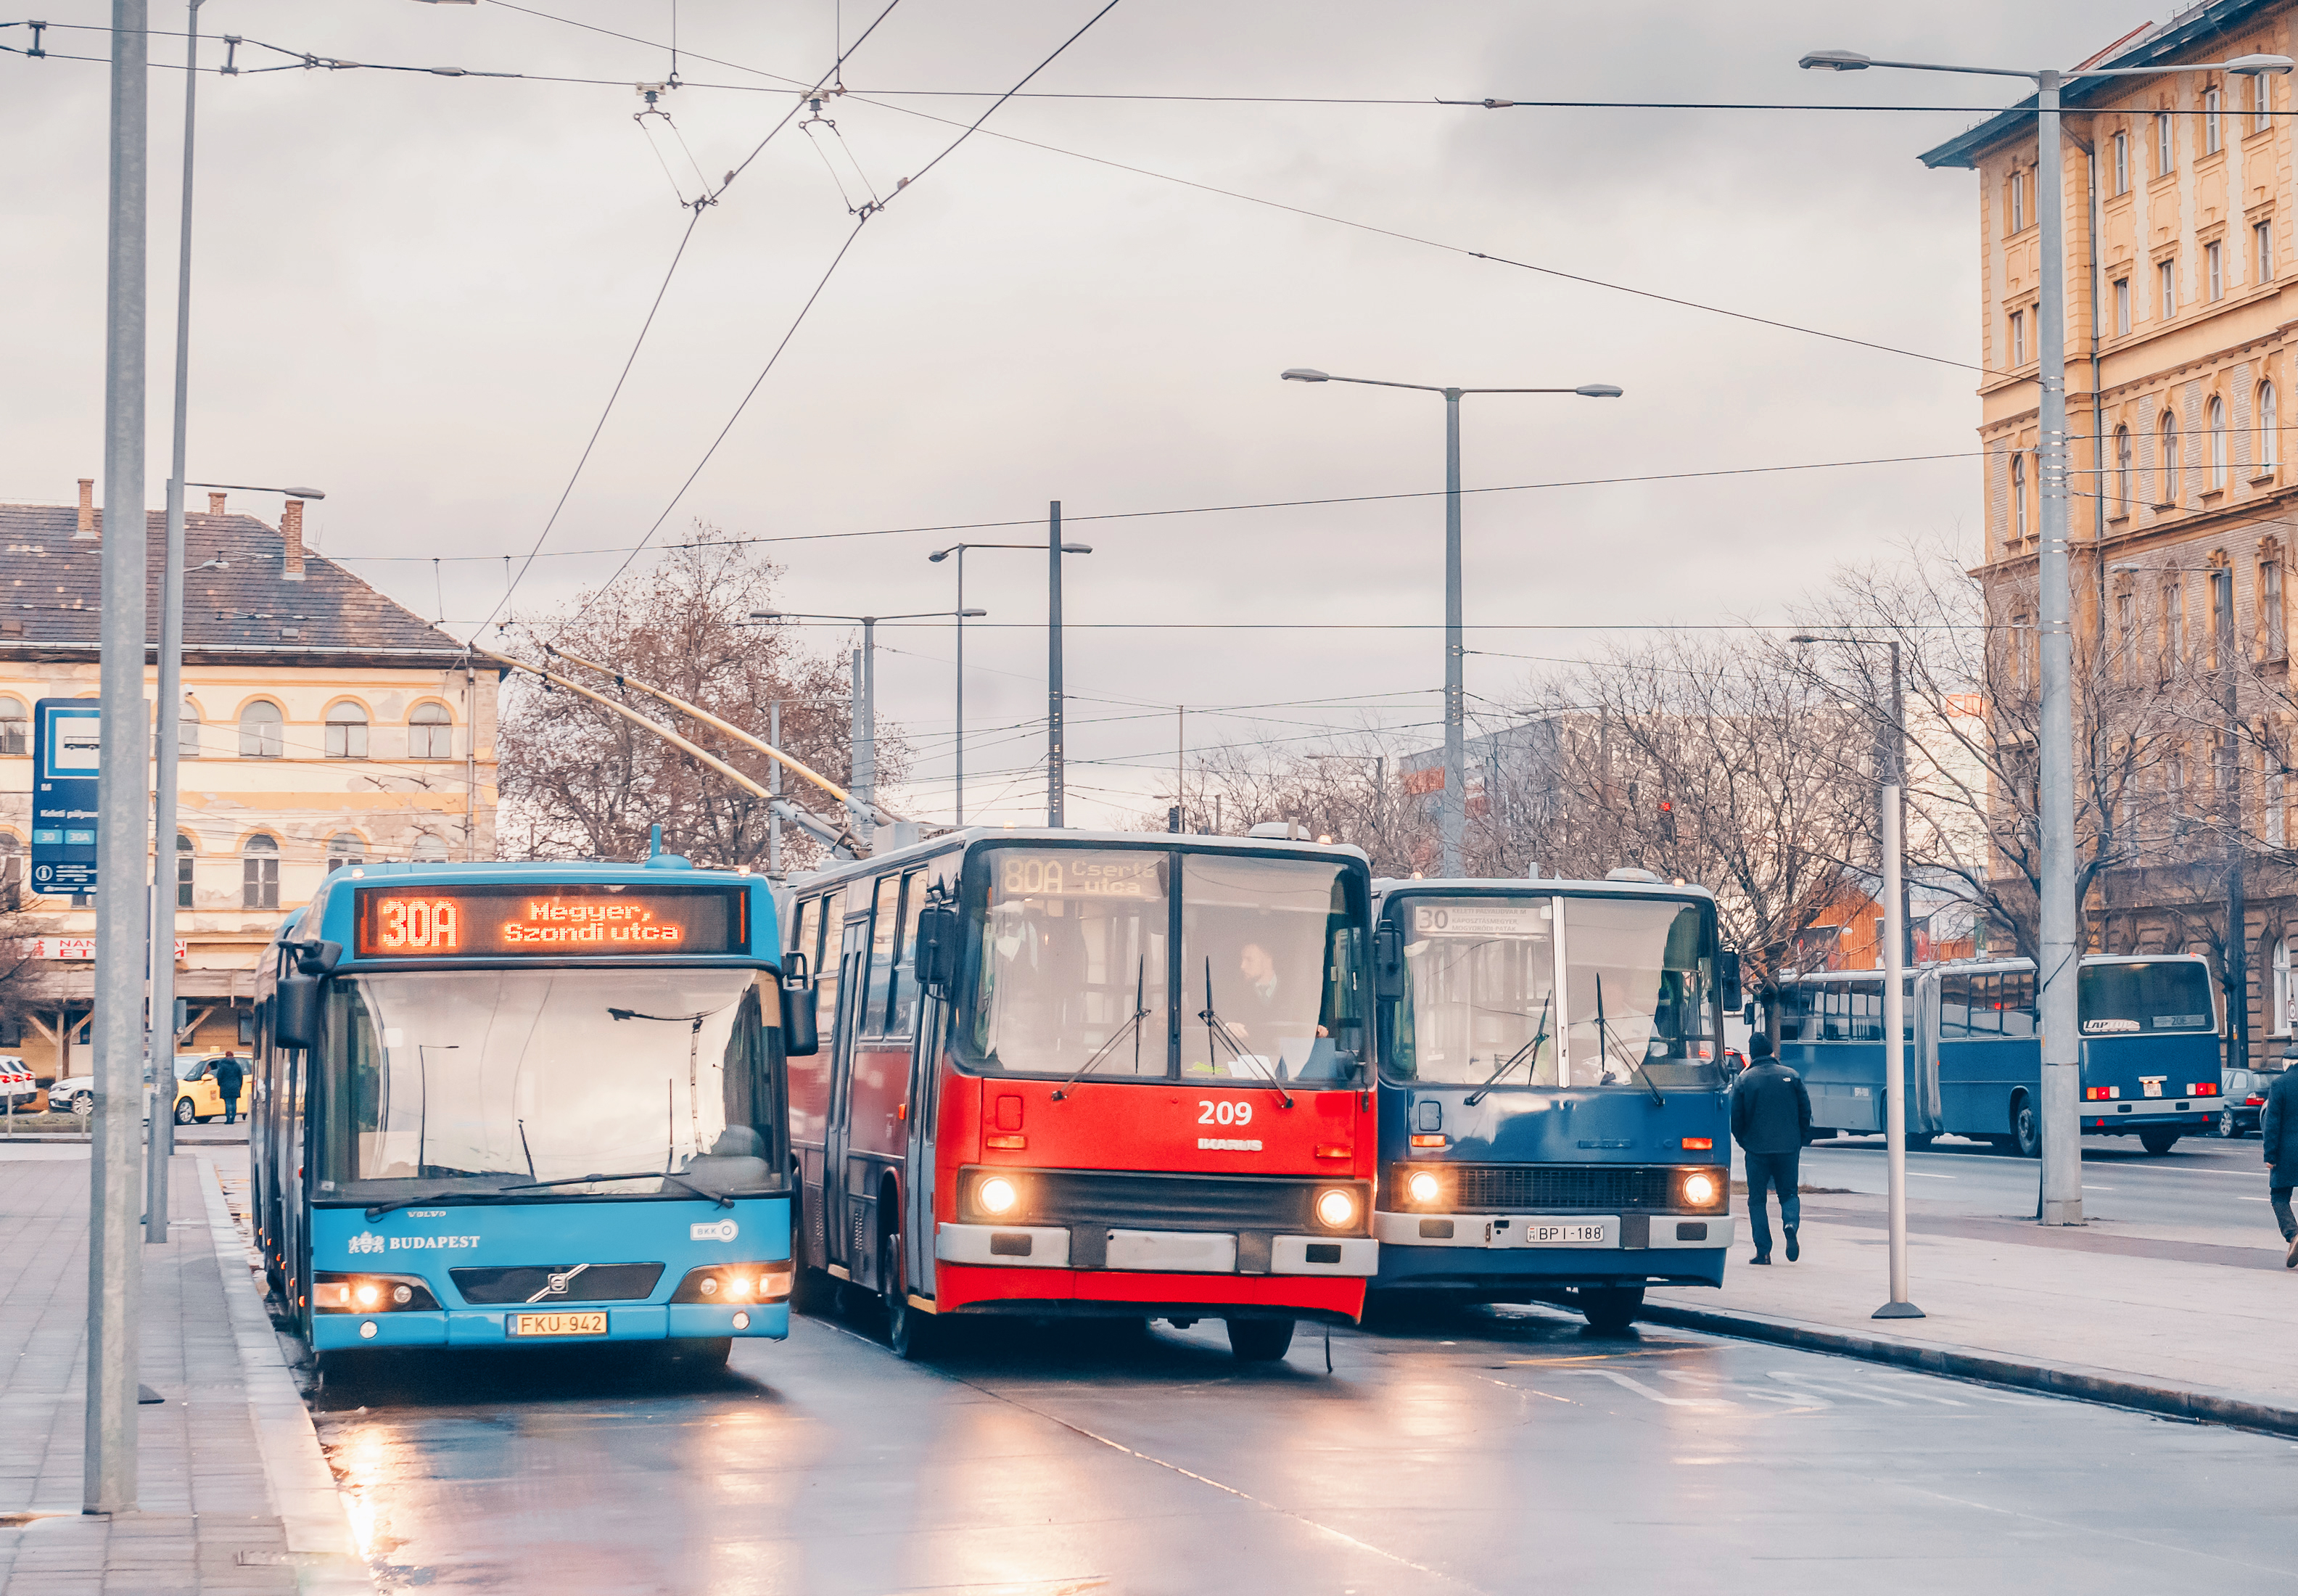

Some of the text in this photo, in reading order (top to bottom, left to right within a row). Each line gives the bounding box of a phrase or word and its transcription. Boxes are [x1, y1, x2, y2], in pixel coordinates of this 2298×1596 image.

[1005, 859, 1063, 894] 80A
[1084, 877, 1141, 894] utca
[383, 900, 458, 947] 30A
[1419, 910, 1449, 929] 30
[504, 922, 679, 942] Szondi utca
[1198, 1100, 1253, 1125] 209
[1197, 1138, 1263, 1151] IKARUS
[390, 1235, 481, 1250] BUDAPEST
[1539, 1227, 1602, 1240] BPI-188
[521, 1315, 602, 1333] FKU-942
